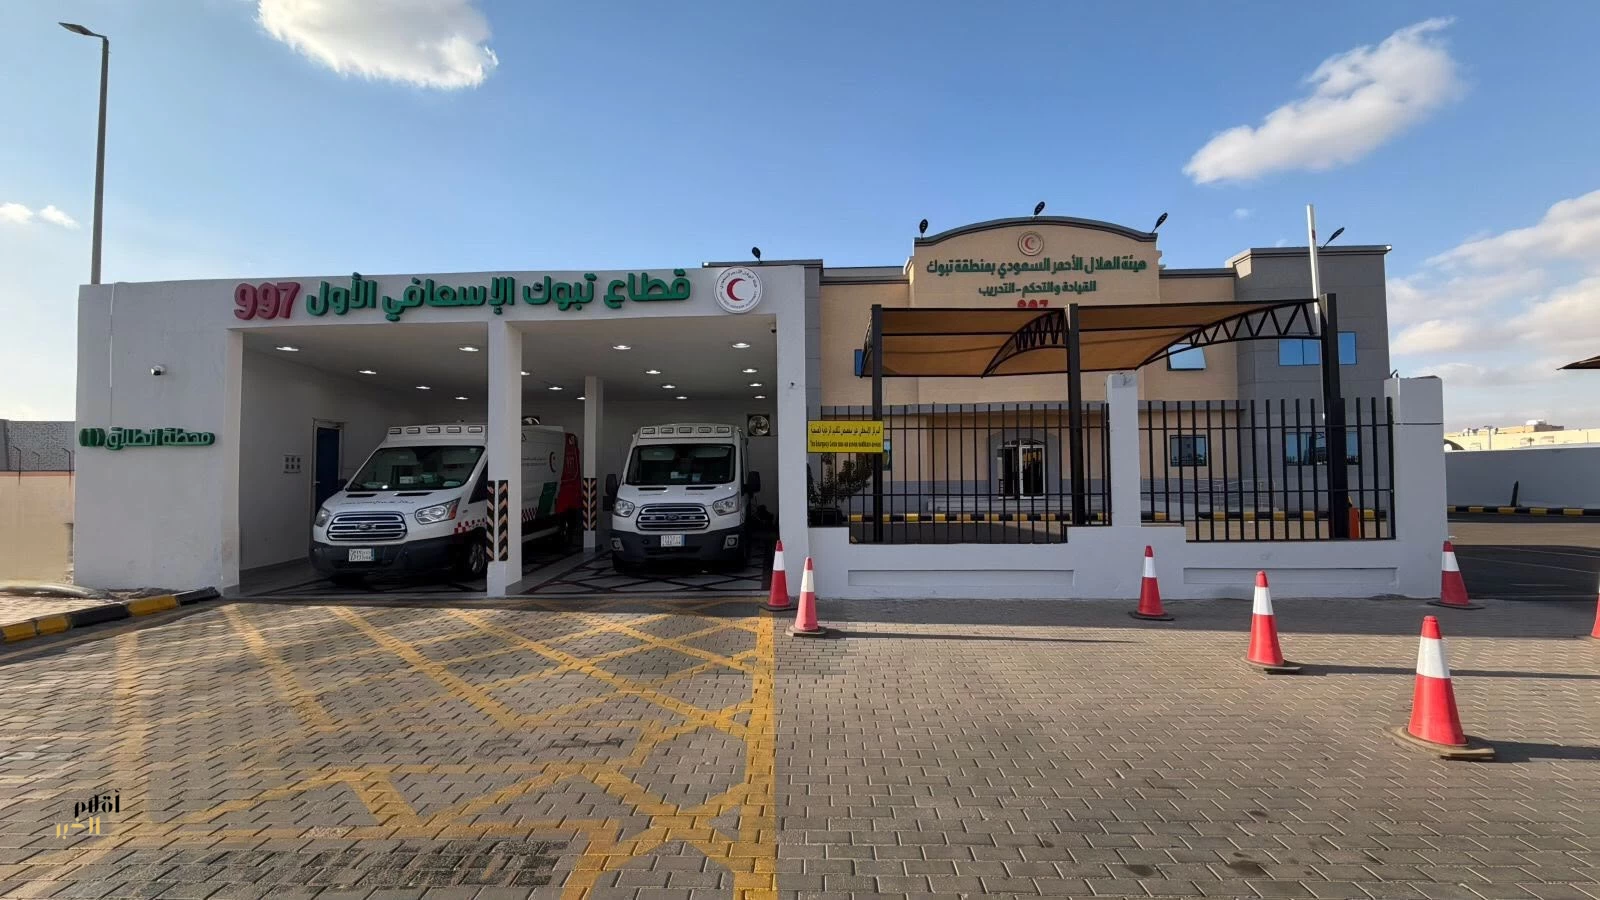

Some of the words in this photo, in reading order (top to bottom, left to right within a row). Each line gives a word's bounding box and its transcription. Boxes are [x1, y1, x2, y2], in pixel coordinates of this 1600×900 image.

[926, 259, 953, 277] تبوك
[955, 259, 996, 275] بمنطقة
[998, 257, 1050, 279] السعودي
[1051, 254, 1083, 275] الأحمر
[1084, 256, 1121, 274] الهلال
[1121, 254, 1147, 272] هيئة
[306, 271, 377, 316] الأول
[522, 273, 597, 311] تبوك
[603, 268, 691, 309] قطاع
[1062, 280, 1097, 295] القيادة
[234, 281, 300, 320] 997
[382, 276, 515, 322] الإسعافي
[162, 427, 215, 447] محطة
